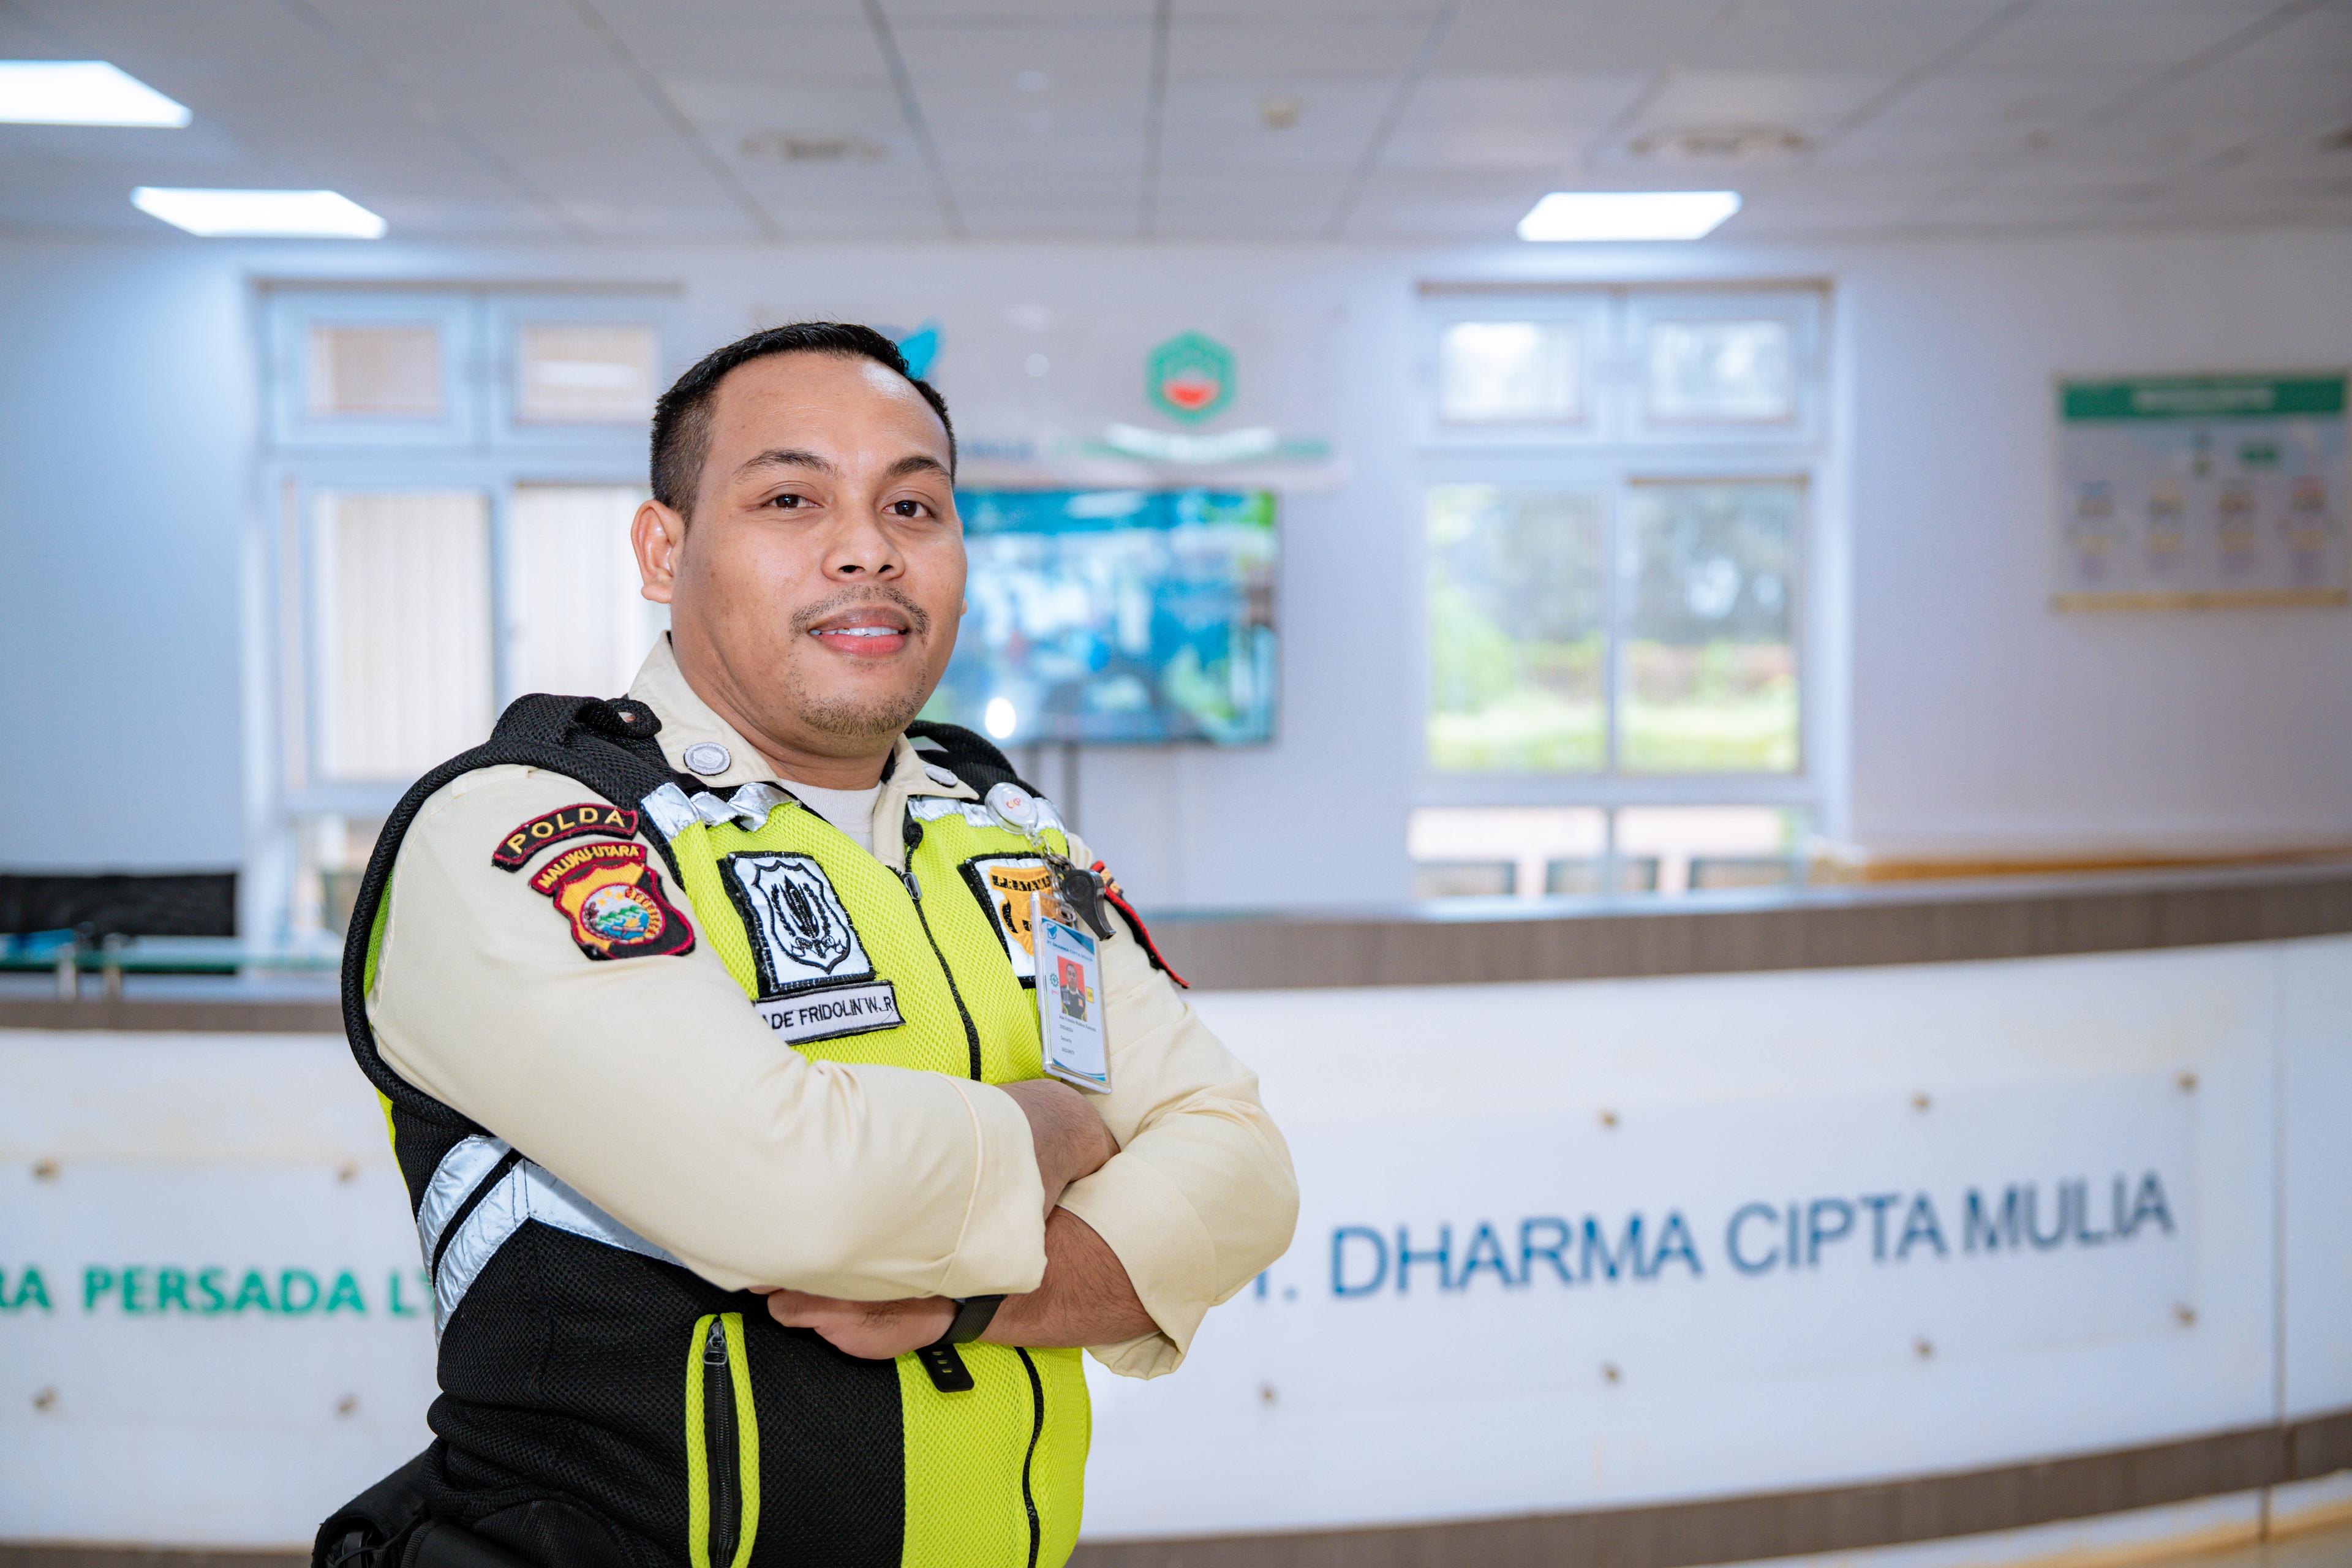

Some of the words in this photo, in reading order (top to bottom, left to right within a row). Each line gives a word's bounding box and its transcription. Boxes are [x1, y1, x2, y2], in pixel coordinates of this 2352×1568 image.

[507, 807, 625, 854] POLDA
[763, 1011, 794, 1030] DE
[800, 998, 863, 1025] FRIDOLIN
[1330, 1210, 1705, 1298] DHARMA
[1725, 1192, 1949, 1276] CIPTA
[1962, 1169, 2176, 1253] MULIA
[83, 1265, 367, 1316] PERSADA
